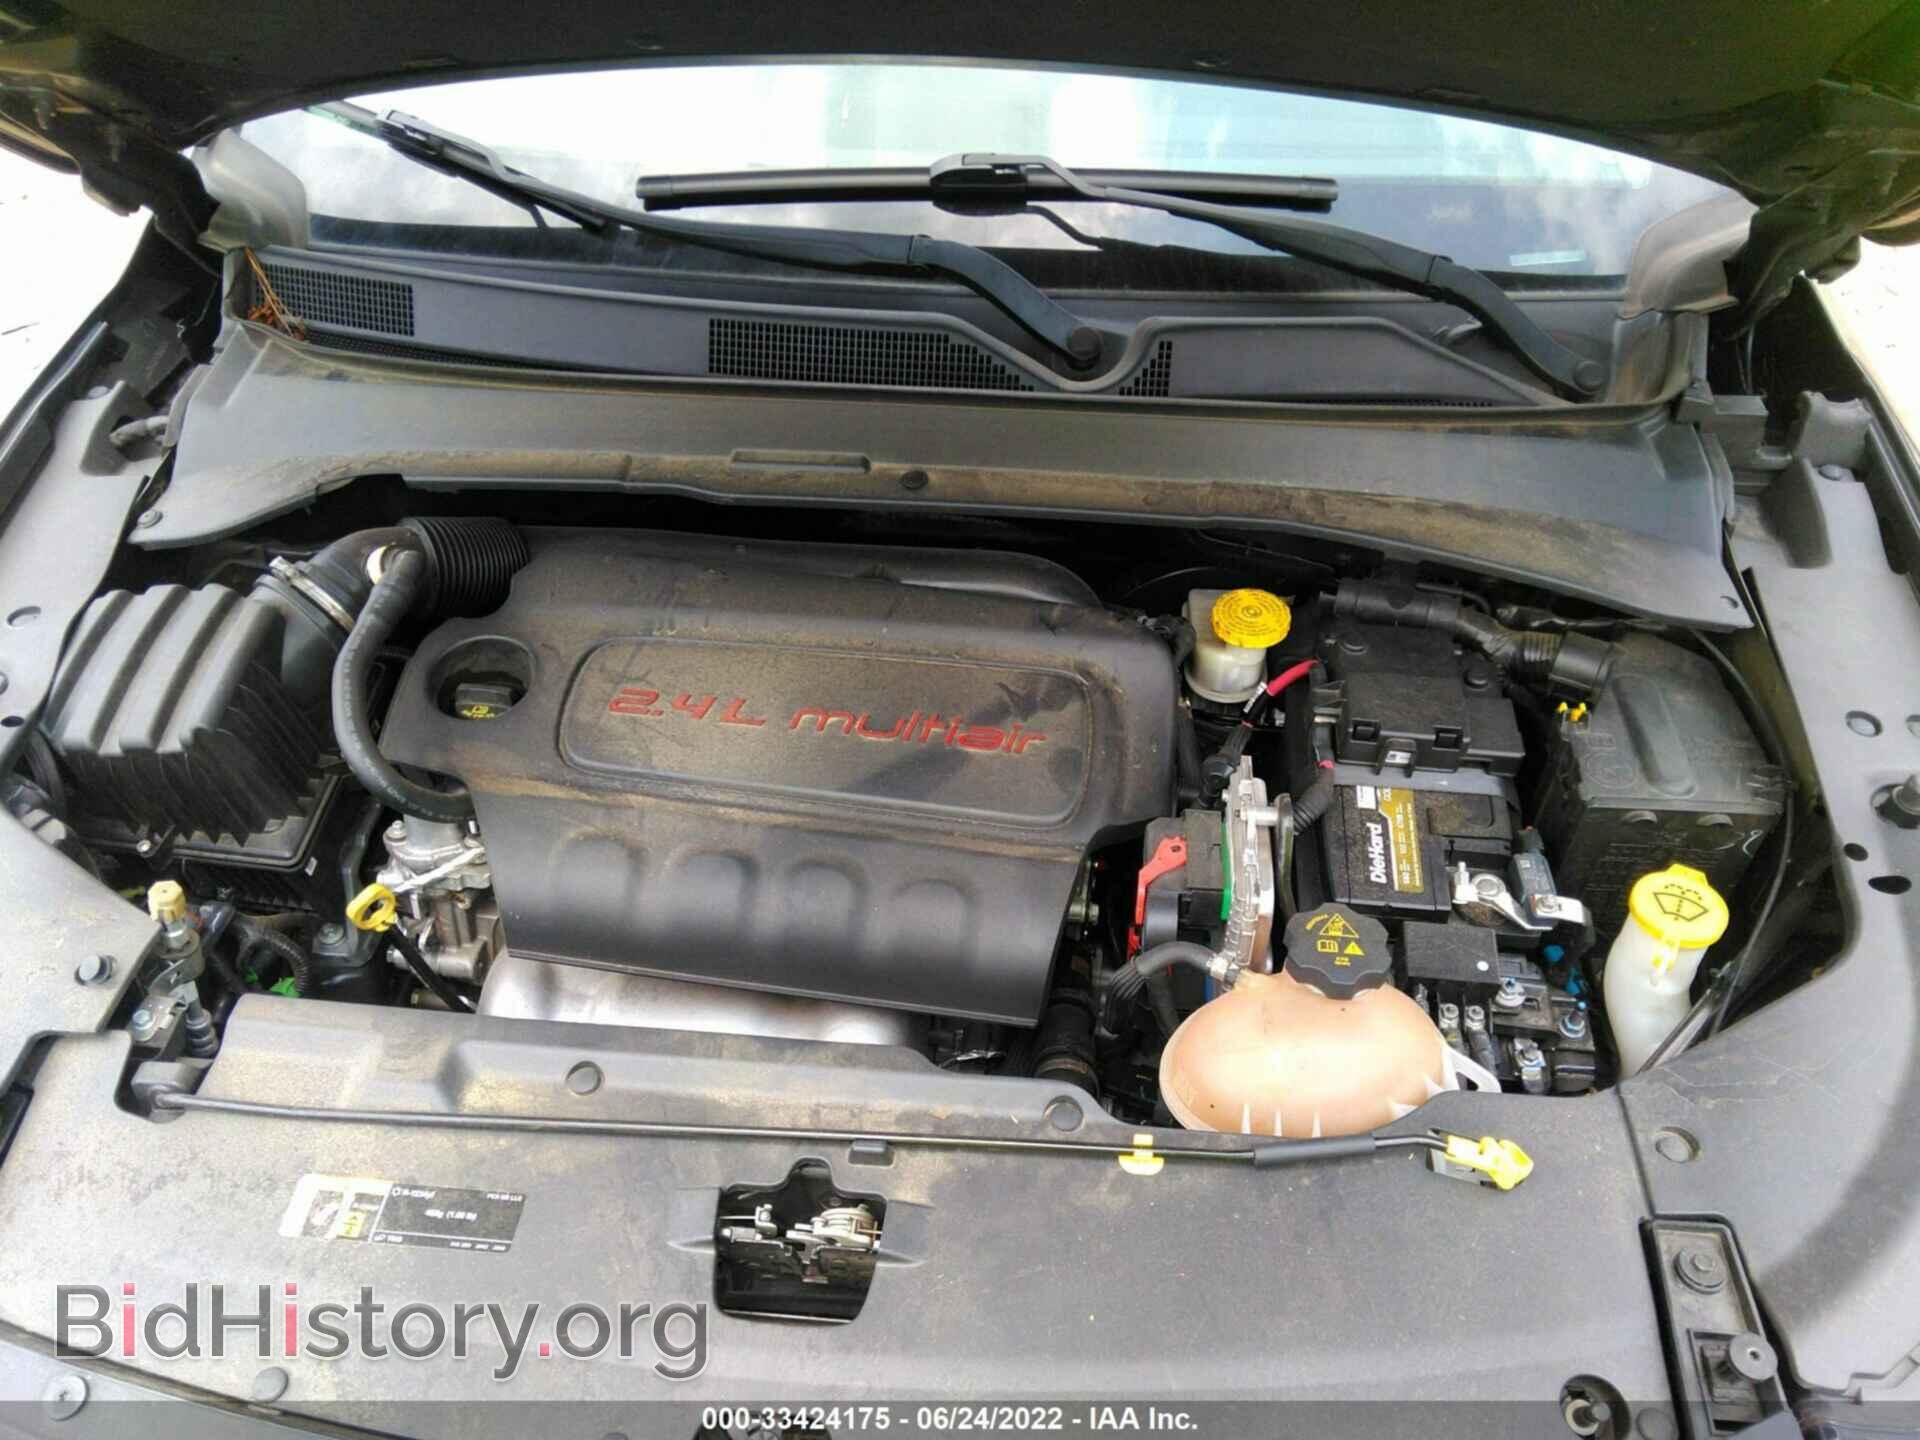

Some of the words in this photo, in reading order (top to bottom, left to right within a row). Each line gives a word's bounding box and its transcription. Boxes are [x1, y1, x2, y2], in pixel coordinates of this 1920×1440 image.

[607, 687, 767, 727] 2.4L
[788, 704, 1048, 755] multiair
[1365, 821, 1388, 885] DieHard
